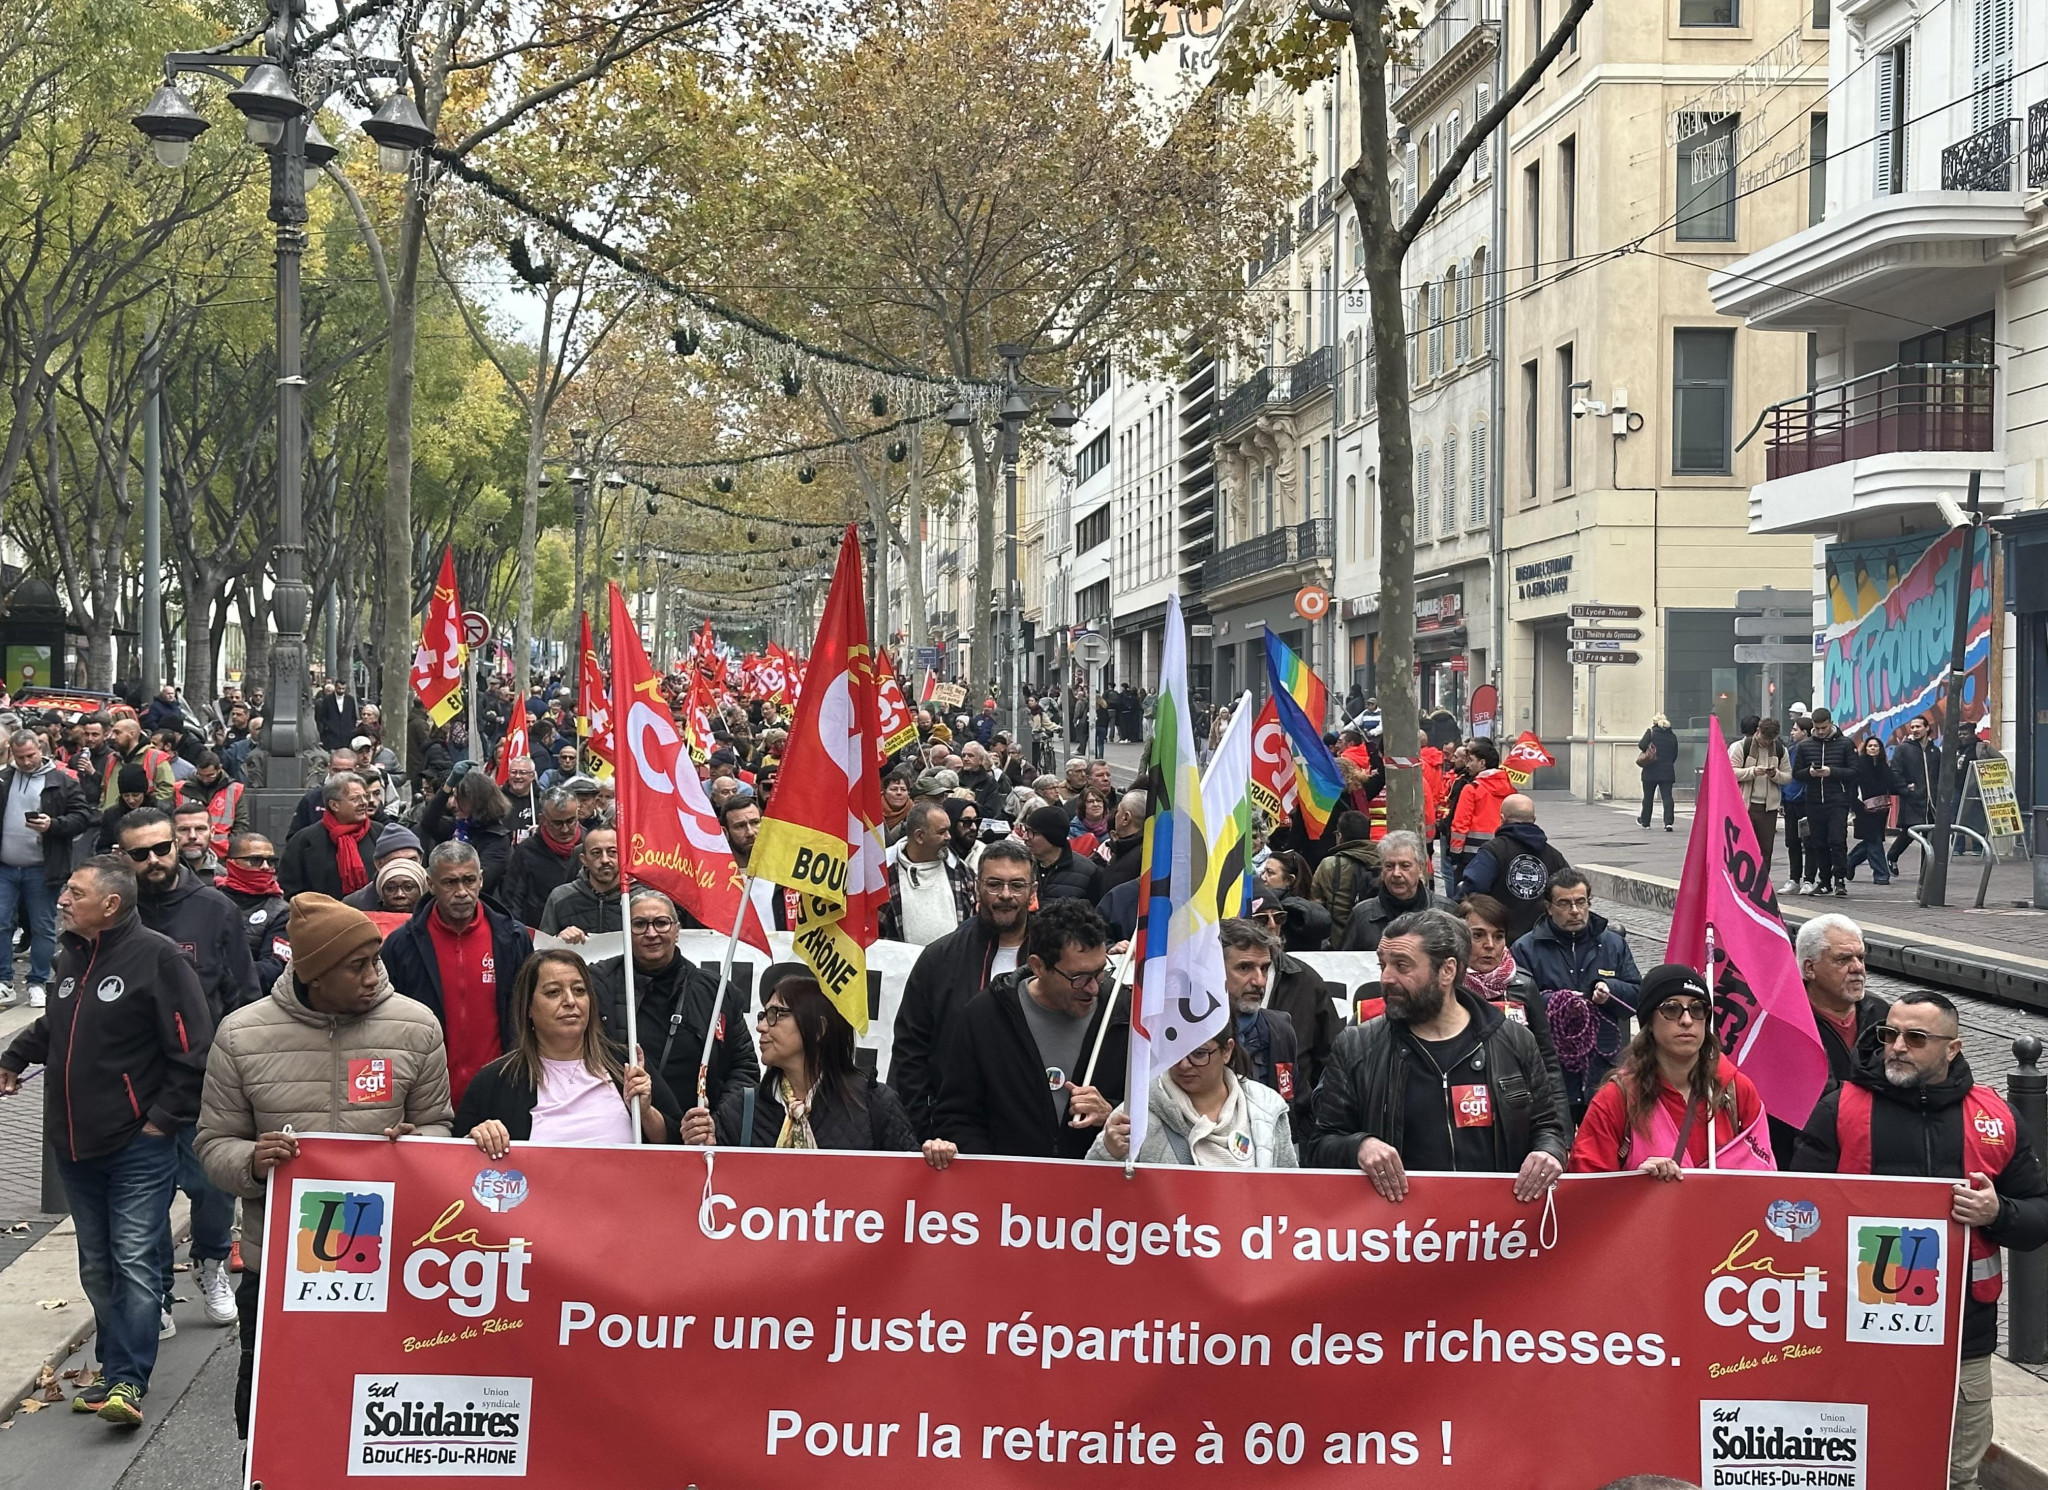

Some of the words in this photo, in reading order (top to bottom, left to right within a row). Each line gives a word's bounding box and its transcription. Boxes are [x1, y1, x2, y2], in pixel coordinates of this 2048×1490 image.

[1348, 296, 1363, 307] 35
[1585, 607, 1606, 616] Lycée
[1608, 607, 1628, 616] Thiers
[1586, 630, 1605, 638] Théâtre
[1614, 631, 1637, 640] Gymnase
[1619, 653, 1624, 661] 3
[1474, 711, 1490, 722] SFR
[588, 754, 603, 773] 13
[631, 832, 694, 878] Bouches
[355, 1072, 386, 1093] cgt
[1460, 1098, 1488, 1116] cgt
[1974, 1117, 2006, 1138] cgt
[480, 1180, 521, 1195] FSM
[1773, 1211, 1813, 1224] FSM
[699, 1194, 885, 1243] Contre
[905, 1200, 979, 1245] les
[1001, 1203, 1222, 1265] budgets
[403, 1237, 532, 1318] cgt
[297, 1281, 376, 1302] F.S.U.
[1704, 1266, 1827, 1343] cgt
[1860, 1312, 1935, 1333] F.S.U.
[402, 1330, 458, 1353] Bouches
[460, 1326, 478, 1340] du
[482, 1317, 524, 1335] Rhône
[558, 1302, 696, 1349] Pour
[714, 1317, 814, 1350] une
[828, 1307, 966, 1362] juste
[986, 1311, 1270, 1369] répartition
[1291, 1324, 1383, 1366] des
[1403, 1319, 1681, 1367] richesses.
[1708, 1357, 1759, 1379] Bouches
[1760, 1351, 1779, 1365] du
[1781, 1344, 1823, 1361] Rhône
[483, 1387, 509, 1396] Union
[481, 1399, 521, 1409] syndicale
[363, 1401, 520, 1438] Solidaires
[1820, 1412, 1845, 1423] Union
[766, 1410, 900, 1457] Pour
[918, 1412, 962, 1459] la
[982, 1419, 1177, 1465] retraite
[1195, 1421, 1224, 1465] à
[1245, 1422, 1305, 1465] 60
[1323, 1431, 1420, 1466] ans
[1441, 1421, 1452, 1466] !
[1819, 1425, 1857, 1434] syndicale
[1712, 1425, 1857, 1462] Solidaires
